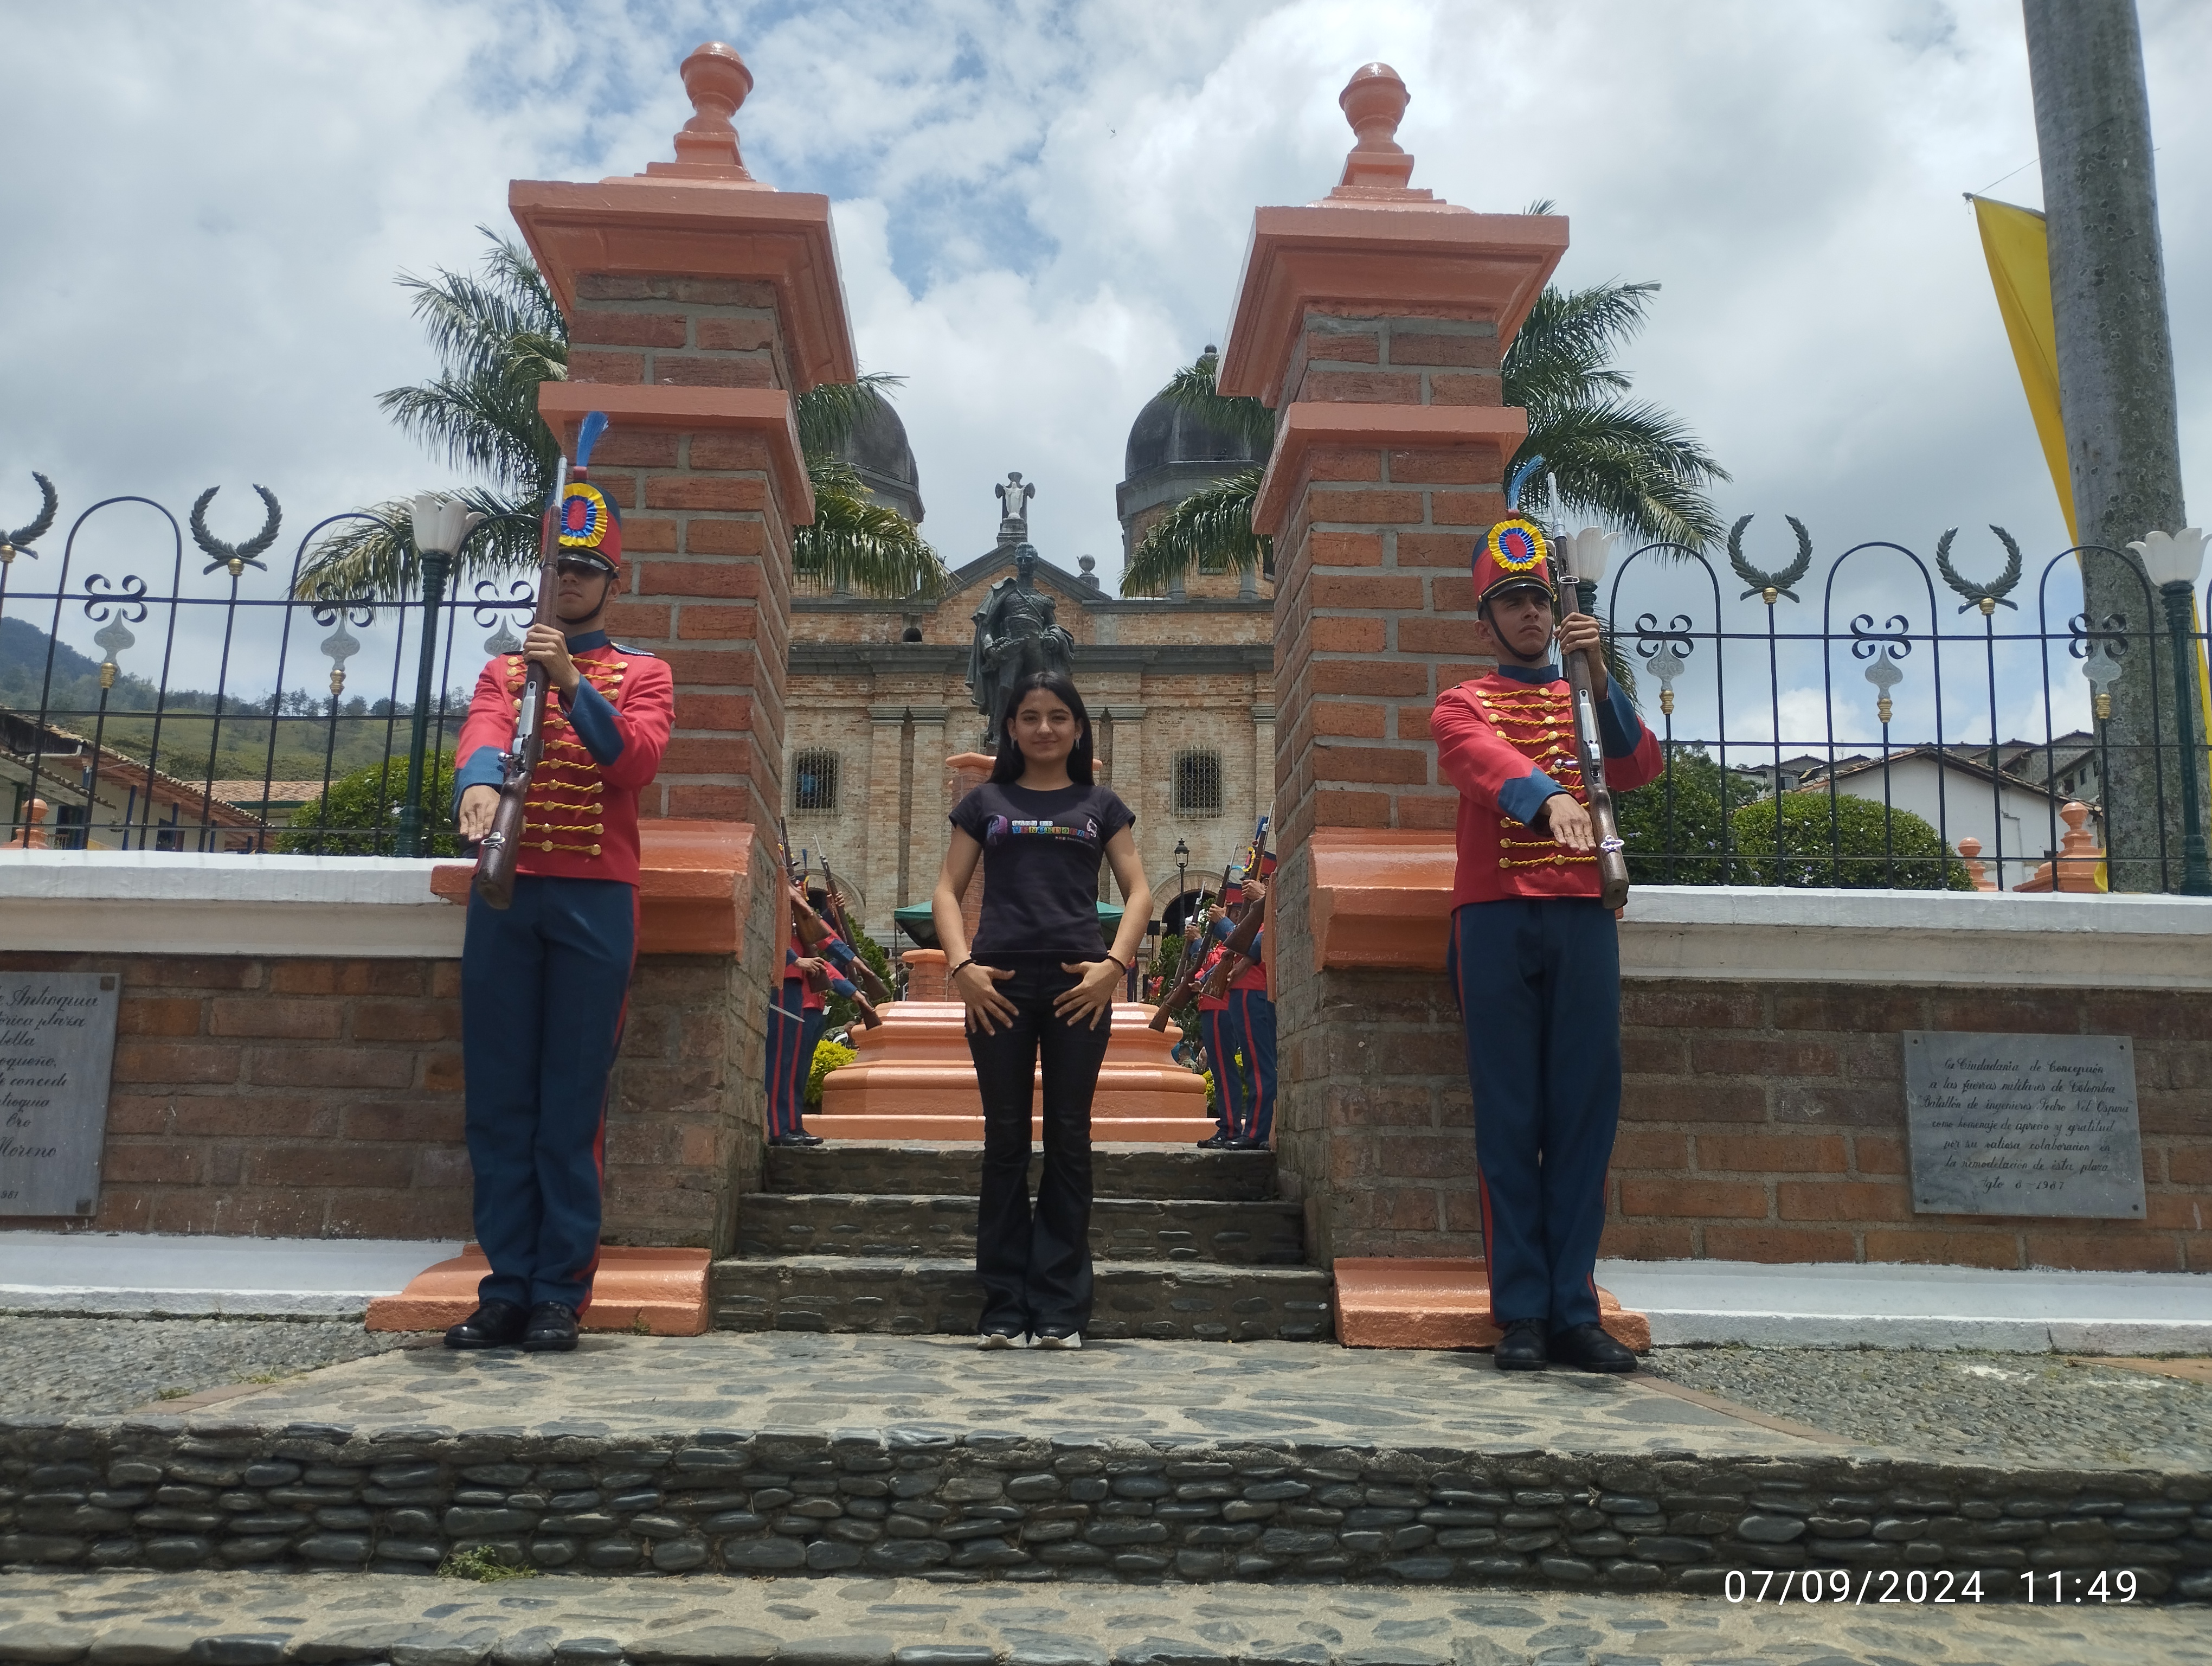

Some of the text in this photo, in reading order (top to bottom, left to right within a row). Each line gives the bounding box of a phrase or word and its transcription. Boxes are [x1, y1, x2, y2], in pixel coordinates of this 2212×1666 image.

[7, 985, 99, 1011] Antioquia
[34, 1012, 87, 1030] plaza
[2029, 1059, 2041, 1072] de
[1928, 1081, 1937, 1089] a
[1943, 1077, 1958, 1089] las
[2000, 1078, 2046, 1092] militares
[2050, 1079, 2063, 1092] de
[2069, 1079, 2115, 1093] Colombia
[1967, 1097, 1978, 1110] de
[1985, 1099, 2031, 1114] ingenieros
[2037, 1097, 2066, 1112] Pedro
[1932, 1116, 2116, 1137] como homenaje de aprecio y gratitud
[1943, 1140, 1960, 1150] por
[1965, 1140, 1978, 1149] su
[1984, 1136, 2021, 1149] valiosa
[2033, 1157, 2044, 1170] de
[2079, 1158, 2110, 1175] plaza
